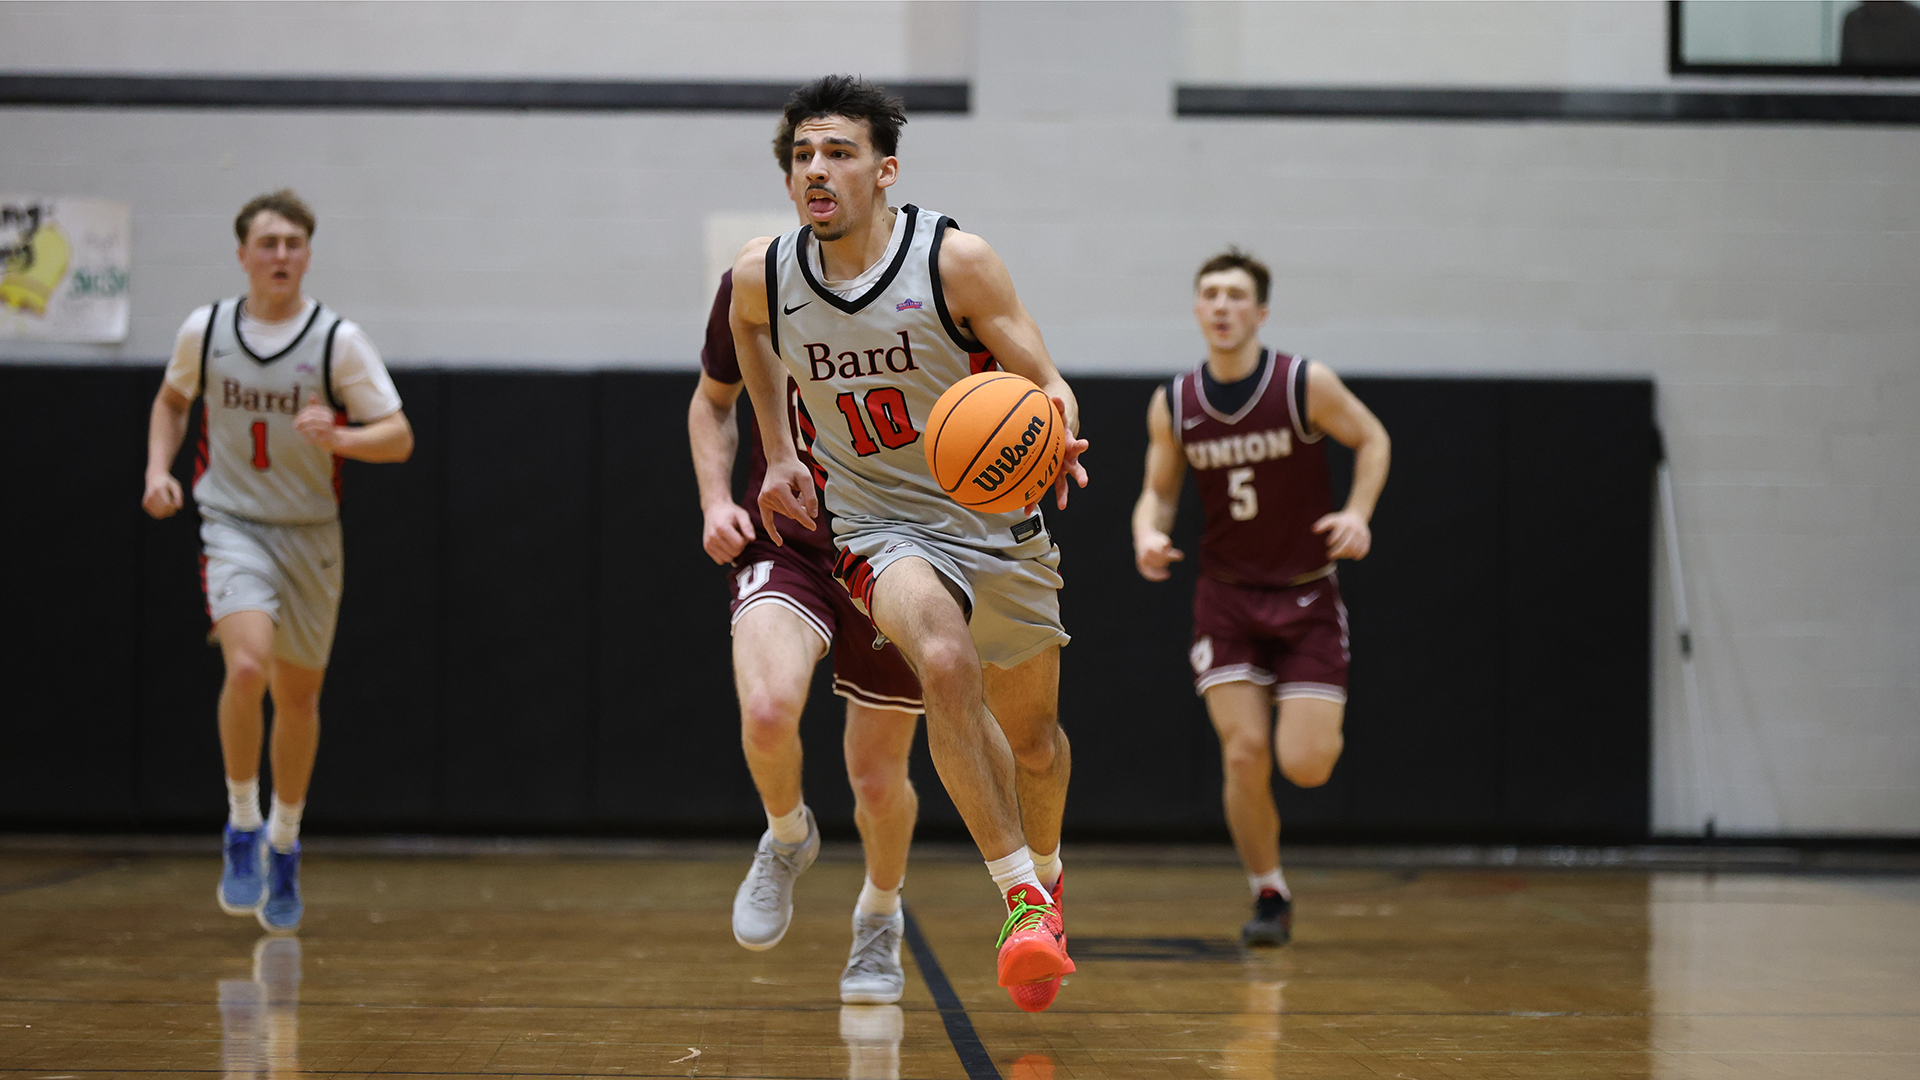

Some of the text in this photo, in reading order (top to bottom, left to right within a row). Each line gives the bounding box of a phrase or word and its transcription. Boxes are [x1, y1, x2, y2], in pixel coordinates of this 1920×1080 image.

[803, 330, 919, 381] Bard
[222, 376, 300, 415] Bard
[251, 420, 270, 471] 1
[836, 387, 920, 457] 10
[972, 415, 1045, 492] Wilson
[1185, 427, 1292, 471] UNION
[1227, 467, 1258, 521] 5
[735, 560, 775, 600] U
